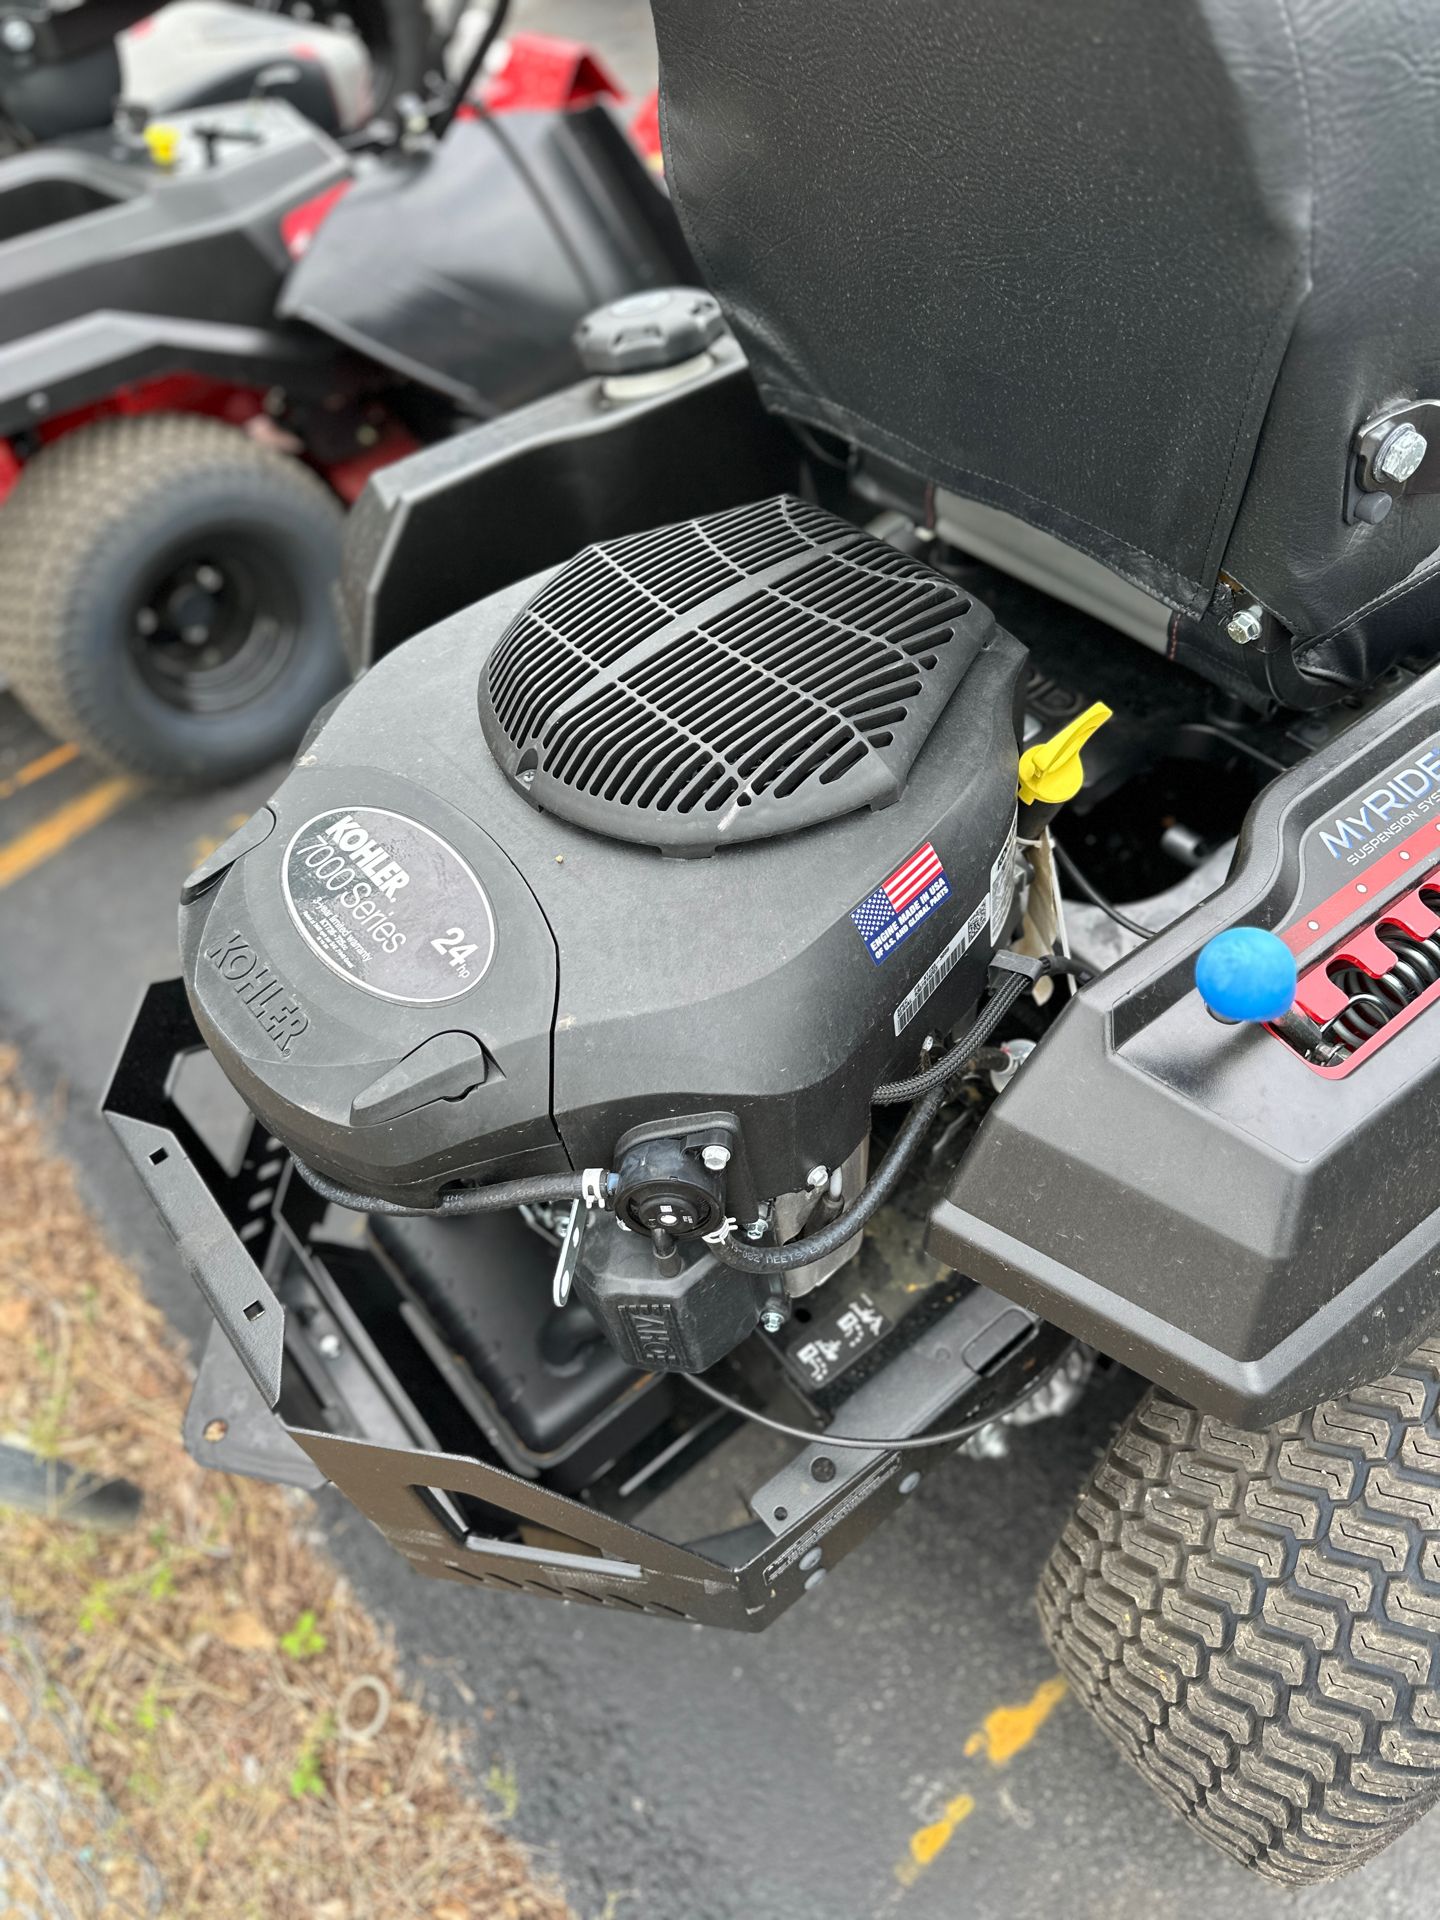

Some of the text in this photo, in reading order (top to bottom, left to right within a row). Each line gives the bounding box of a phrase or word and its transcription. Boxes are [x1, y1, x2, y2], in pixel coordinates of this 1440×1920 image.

[1319, 751, 1440, 860] MYRIDE
[1346, 810, 1420, 866] SUSPENSION
[296, 834, 356, 891] 7000
[340, 882, 407, 953] Series
[869, 877, 946, 952] ENGINE MADE IN USA
[874, 947, 884, 959] OF
[895, 924, 909, 941] AND
[908, 904, 931, 928] GLOBAL
[929, 886, 949, 907] PARTS
[345, 934, 374, 962] warranty
